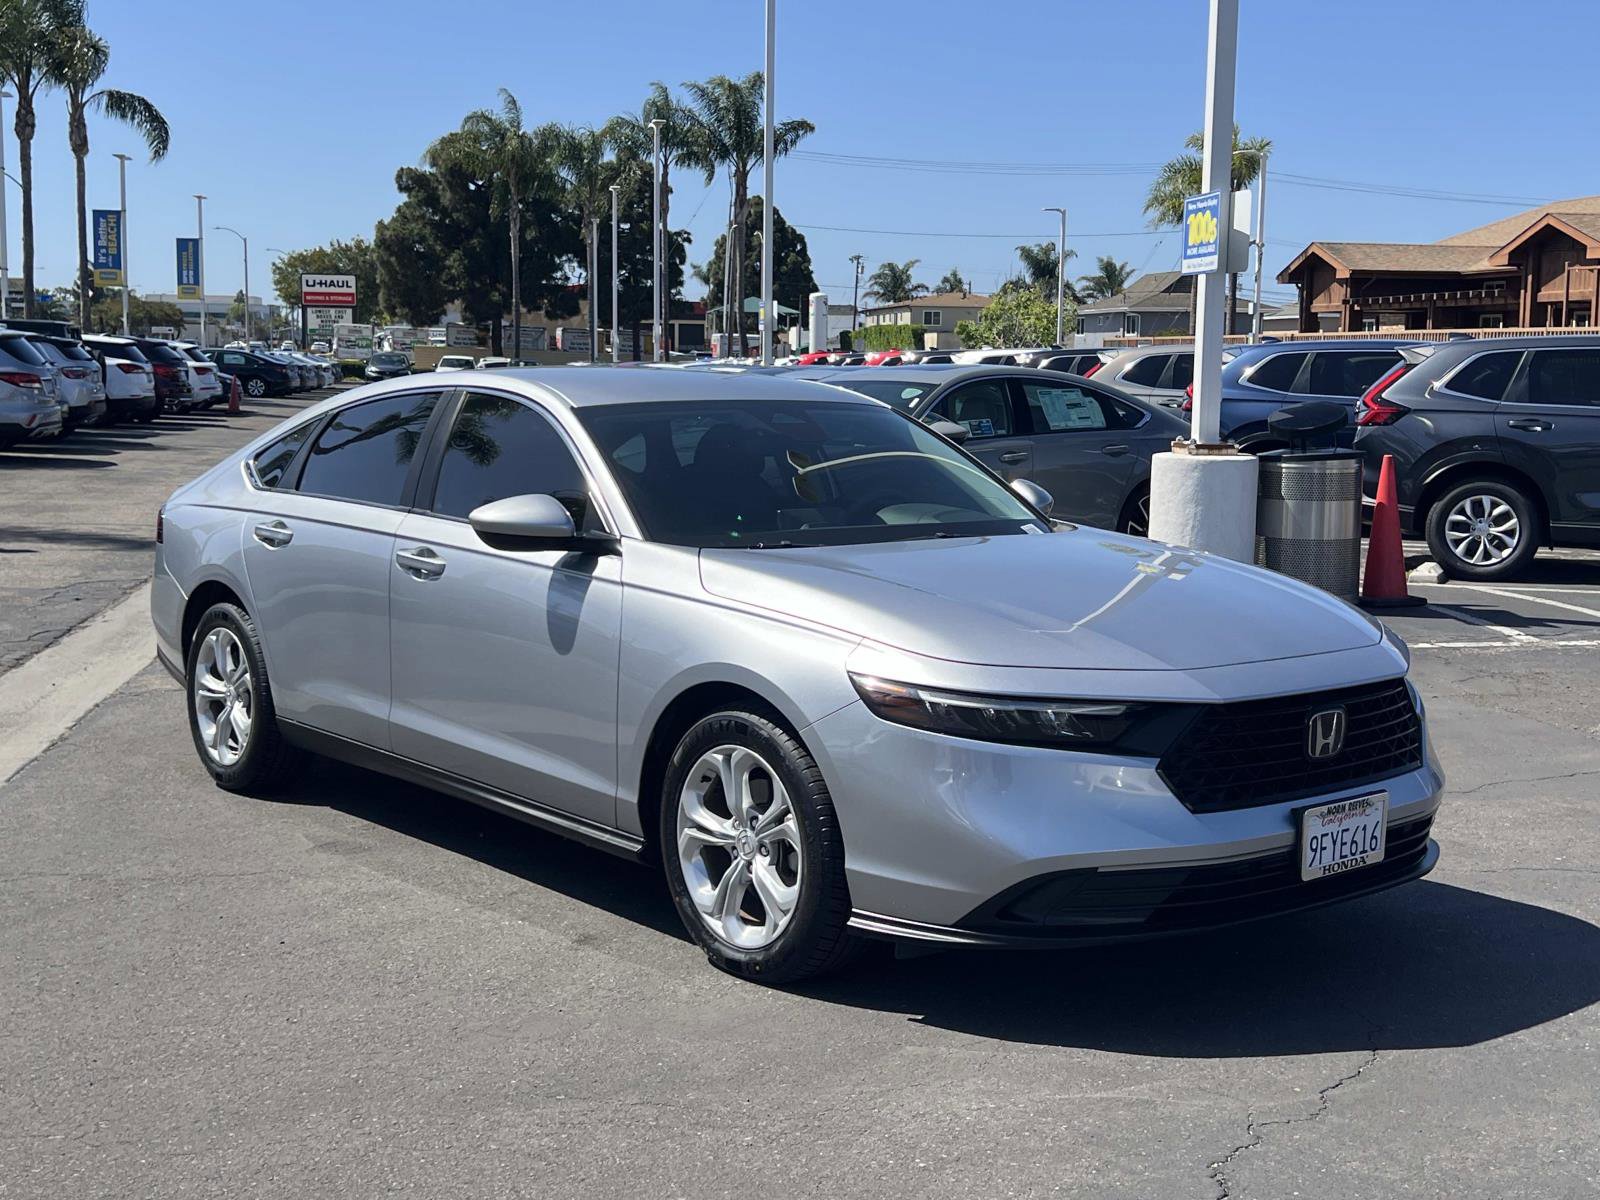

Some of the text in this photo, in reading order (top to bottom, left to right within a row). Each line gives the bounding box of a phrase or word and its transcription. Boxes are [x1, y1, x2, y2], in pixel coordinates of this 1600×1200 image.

[98, 217, 107, 263] It's Better
[107, 215, 118, 255] BEACH!
[305, 279, 353, 289] U-HAUL
[1326, 798, 1370, 816] NORM REEVES
[1308, 820, 1380, 868] 9FYE616
[1322, 857, 1368, 876] HONDA
